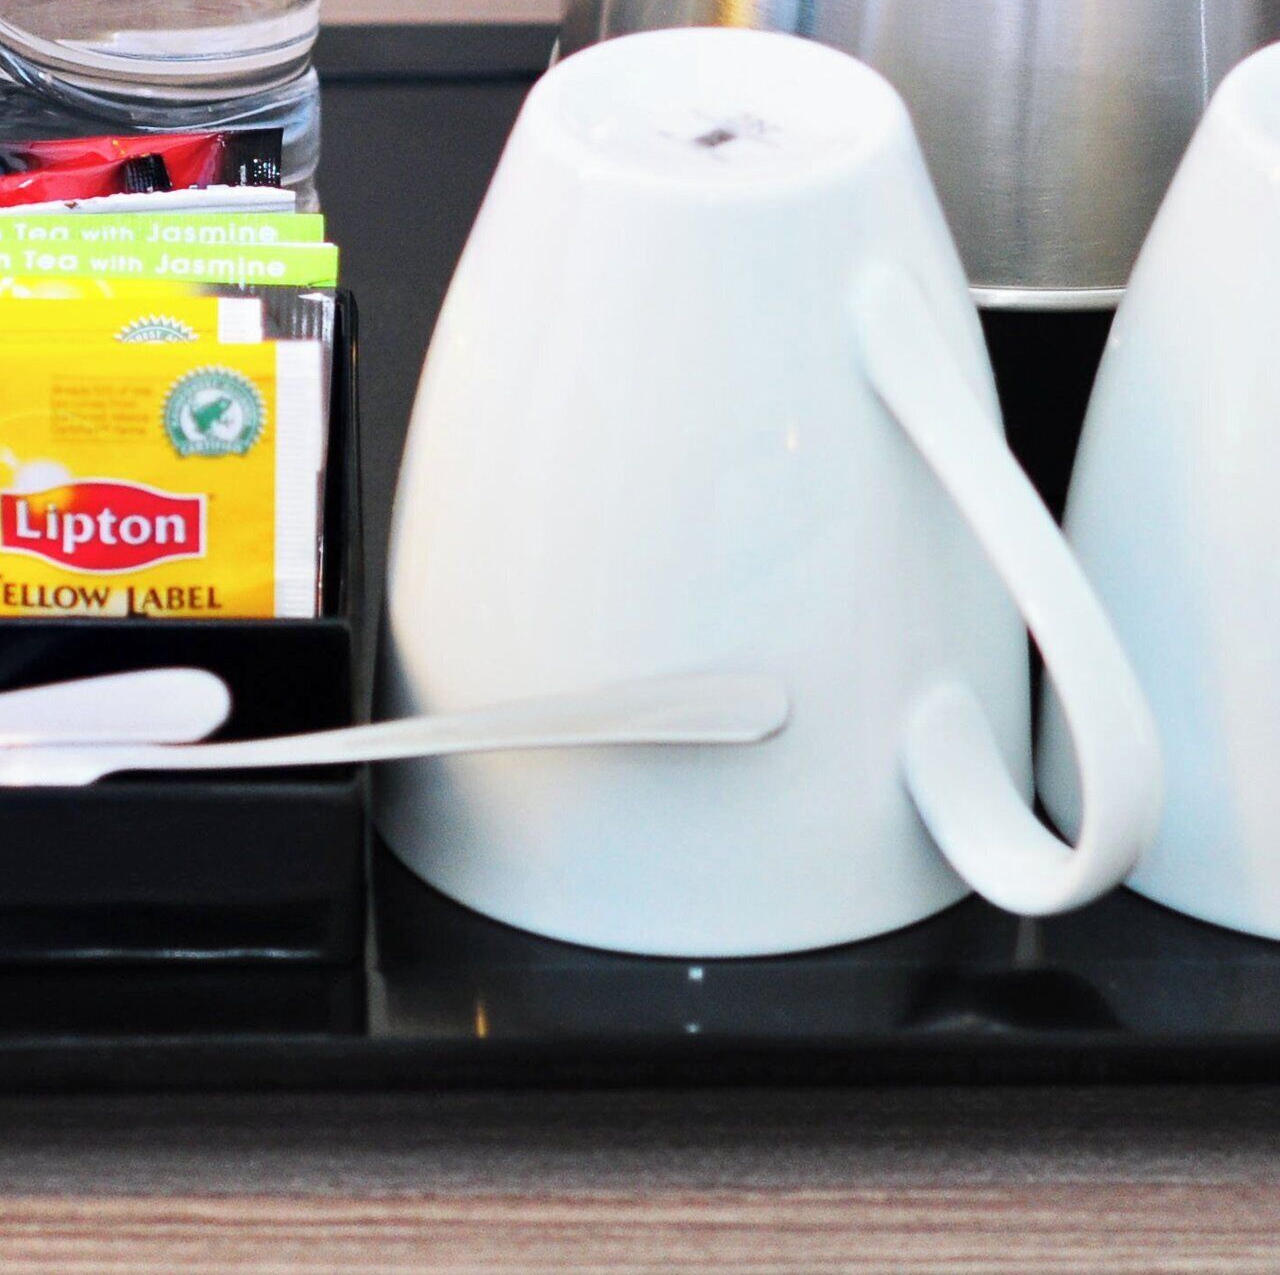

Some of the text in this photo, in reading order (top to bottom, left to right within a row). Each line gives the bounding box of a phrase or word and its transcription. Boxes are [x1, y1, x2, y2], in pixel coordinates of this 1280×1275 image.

[15, 223, 71, 241] Tea
[81, 224, 135, 242] with
[146, 222, 279, 243] Jasmine
[23, 249, 79, 270] Tea
[90, 254, 143, 273] with
[155, 253, 286, 277] Jasmine
[16, 500, 186, 554] Lipton
[127, 585, 222, 617] LABEL
